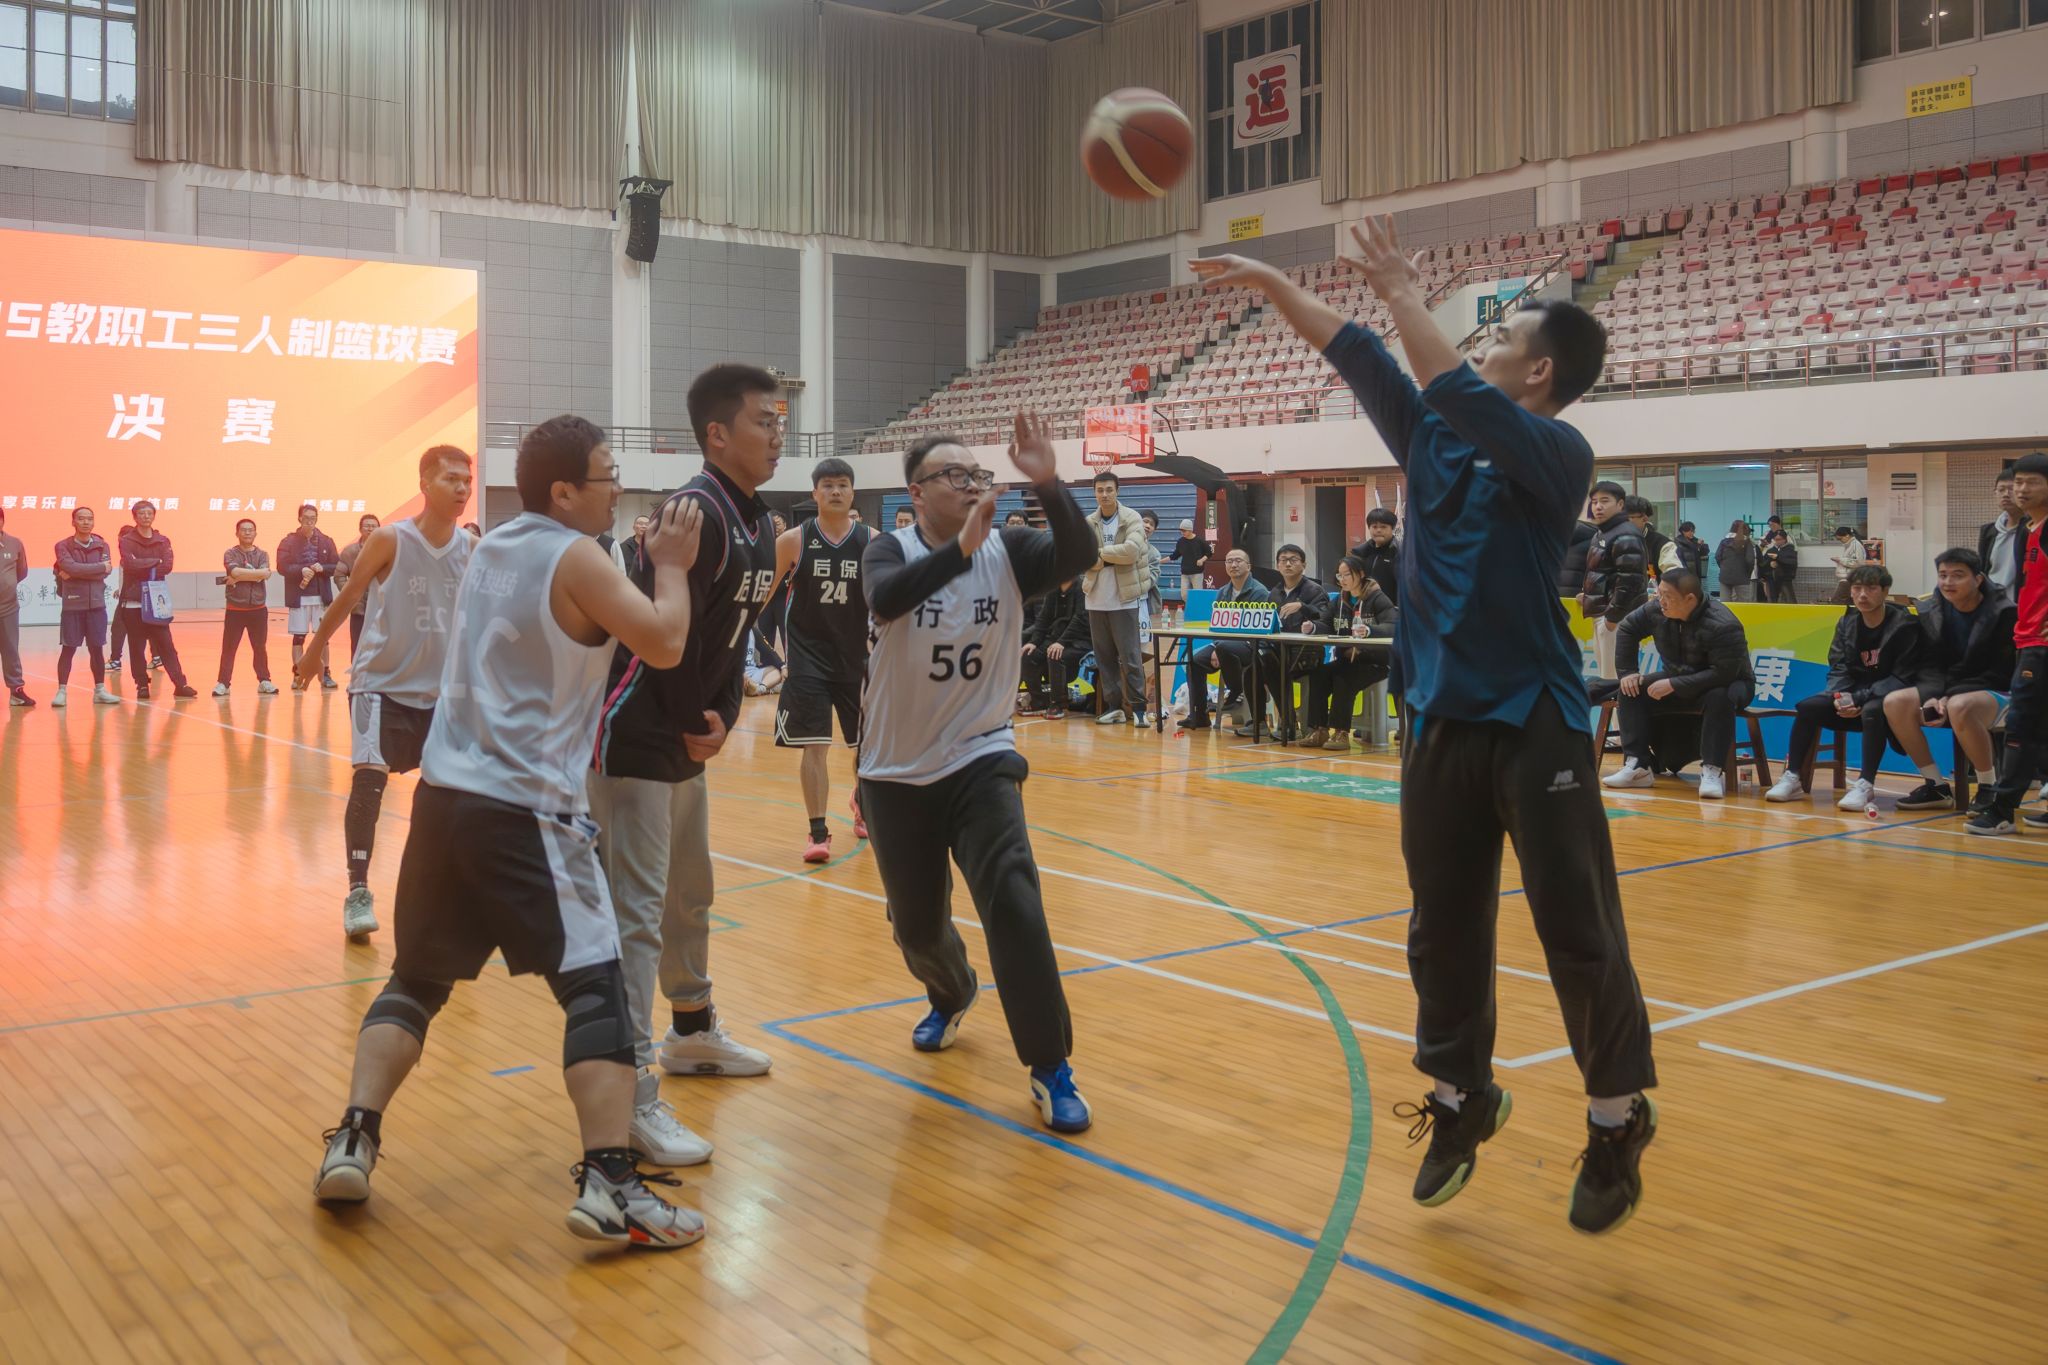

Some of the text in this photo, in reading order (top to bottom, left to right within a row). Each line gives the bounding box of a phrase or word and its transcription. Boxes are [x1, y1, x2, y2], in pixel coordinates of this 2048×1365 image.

[0, 301, 458, 365] 5教职工三人制篮球赛
[813, 558, 858, 579] 后保
[820, 580, 848, 605] 24
[914, 595, 999, 629] 行政
[1211, 610, 1273, 628] 006 005
[928, 643, 983, 682] 56
